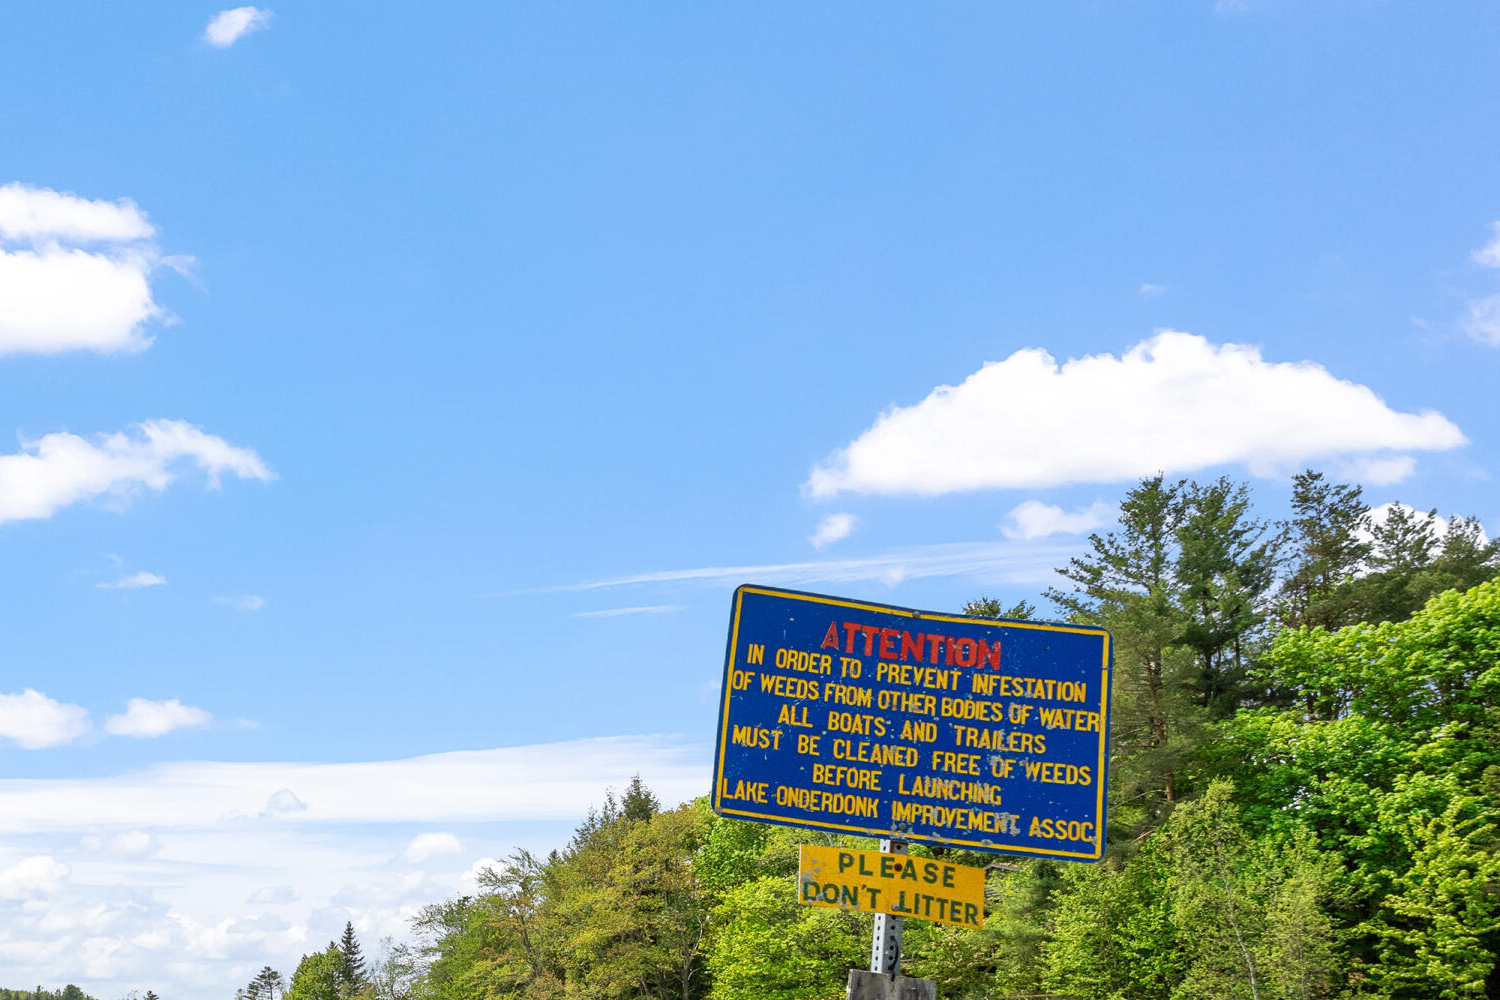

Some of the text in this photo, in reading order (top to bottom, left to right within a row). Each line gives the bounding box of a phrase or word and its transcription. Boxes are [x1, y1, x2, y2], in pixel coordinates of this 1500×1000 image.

[821, 621, 1000, 670] ATTENTION
[747, 644, 1086, 702] IN ORDER TO PREVENT INFESTATION
[732, 670, 1100, 732] OF WEEDS FROM OTHER BODIES OF WATER
[777, 704, 1046, 754] ALL BOATS AND TRAILERS
[732, 725, 1091, 786] MUST BE CLEANED FREE OF WEEDS
[723, 778, 769, 804] LAKE
[776, 785, 879, 818] ONDERDONK
[892, 801, 1020, 834] IMPROVEMENT
[812, 763, 1002, 805] BEFORE LAUNCHING
[839, 852, 956, 888] PLEASE
[803, 880, 978, 926] DON'T LITTER
